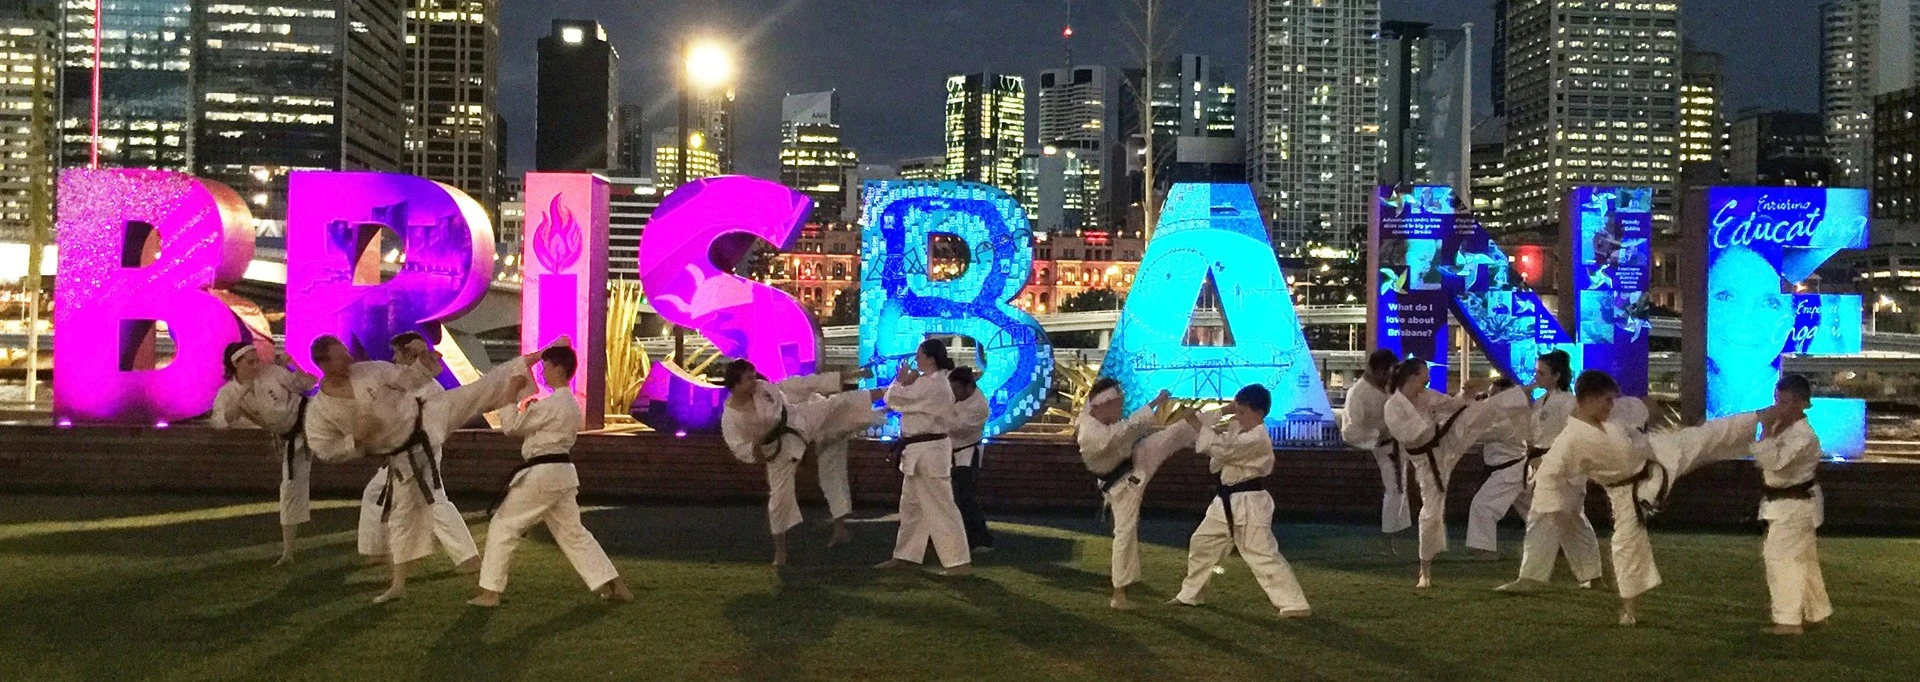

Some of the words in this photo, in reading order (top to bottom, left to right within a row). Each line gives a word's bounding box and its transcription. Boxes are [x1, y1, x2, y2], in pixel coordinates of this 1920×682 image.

[1388, 303, 1413, 311] What
[1415, 303, 1428, 311] do
[53, 167, 1869, 461] BRISBANE
[1386, 315, 1406, 324] love
[1407, 316, 1435, 324] about
[1387, 328, 1433, 337] Brisbane?
